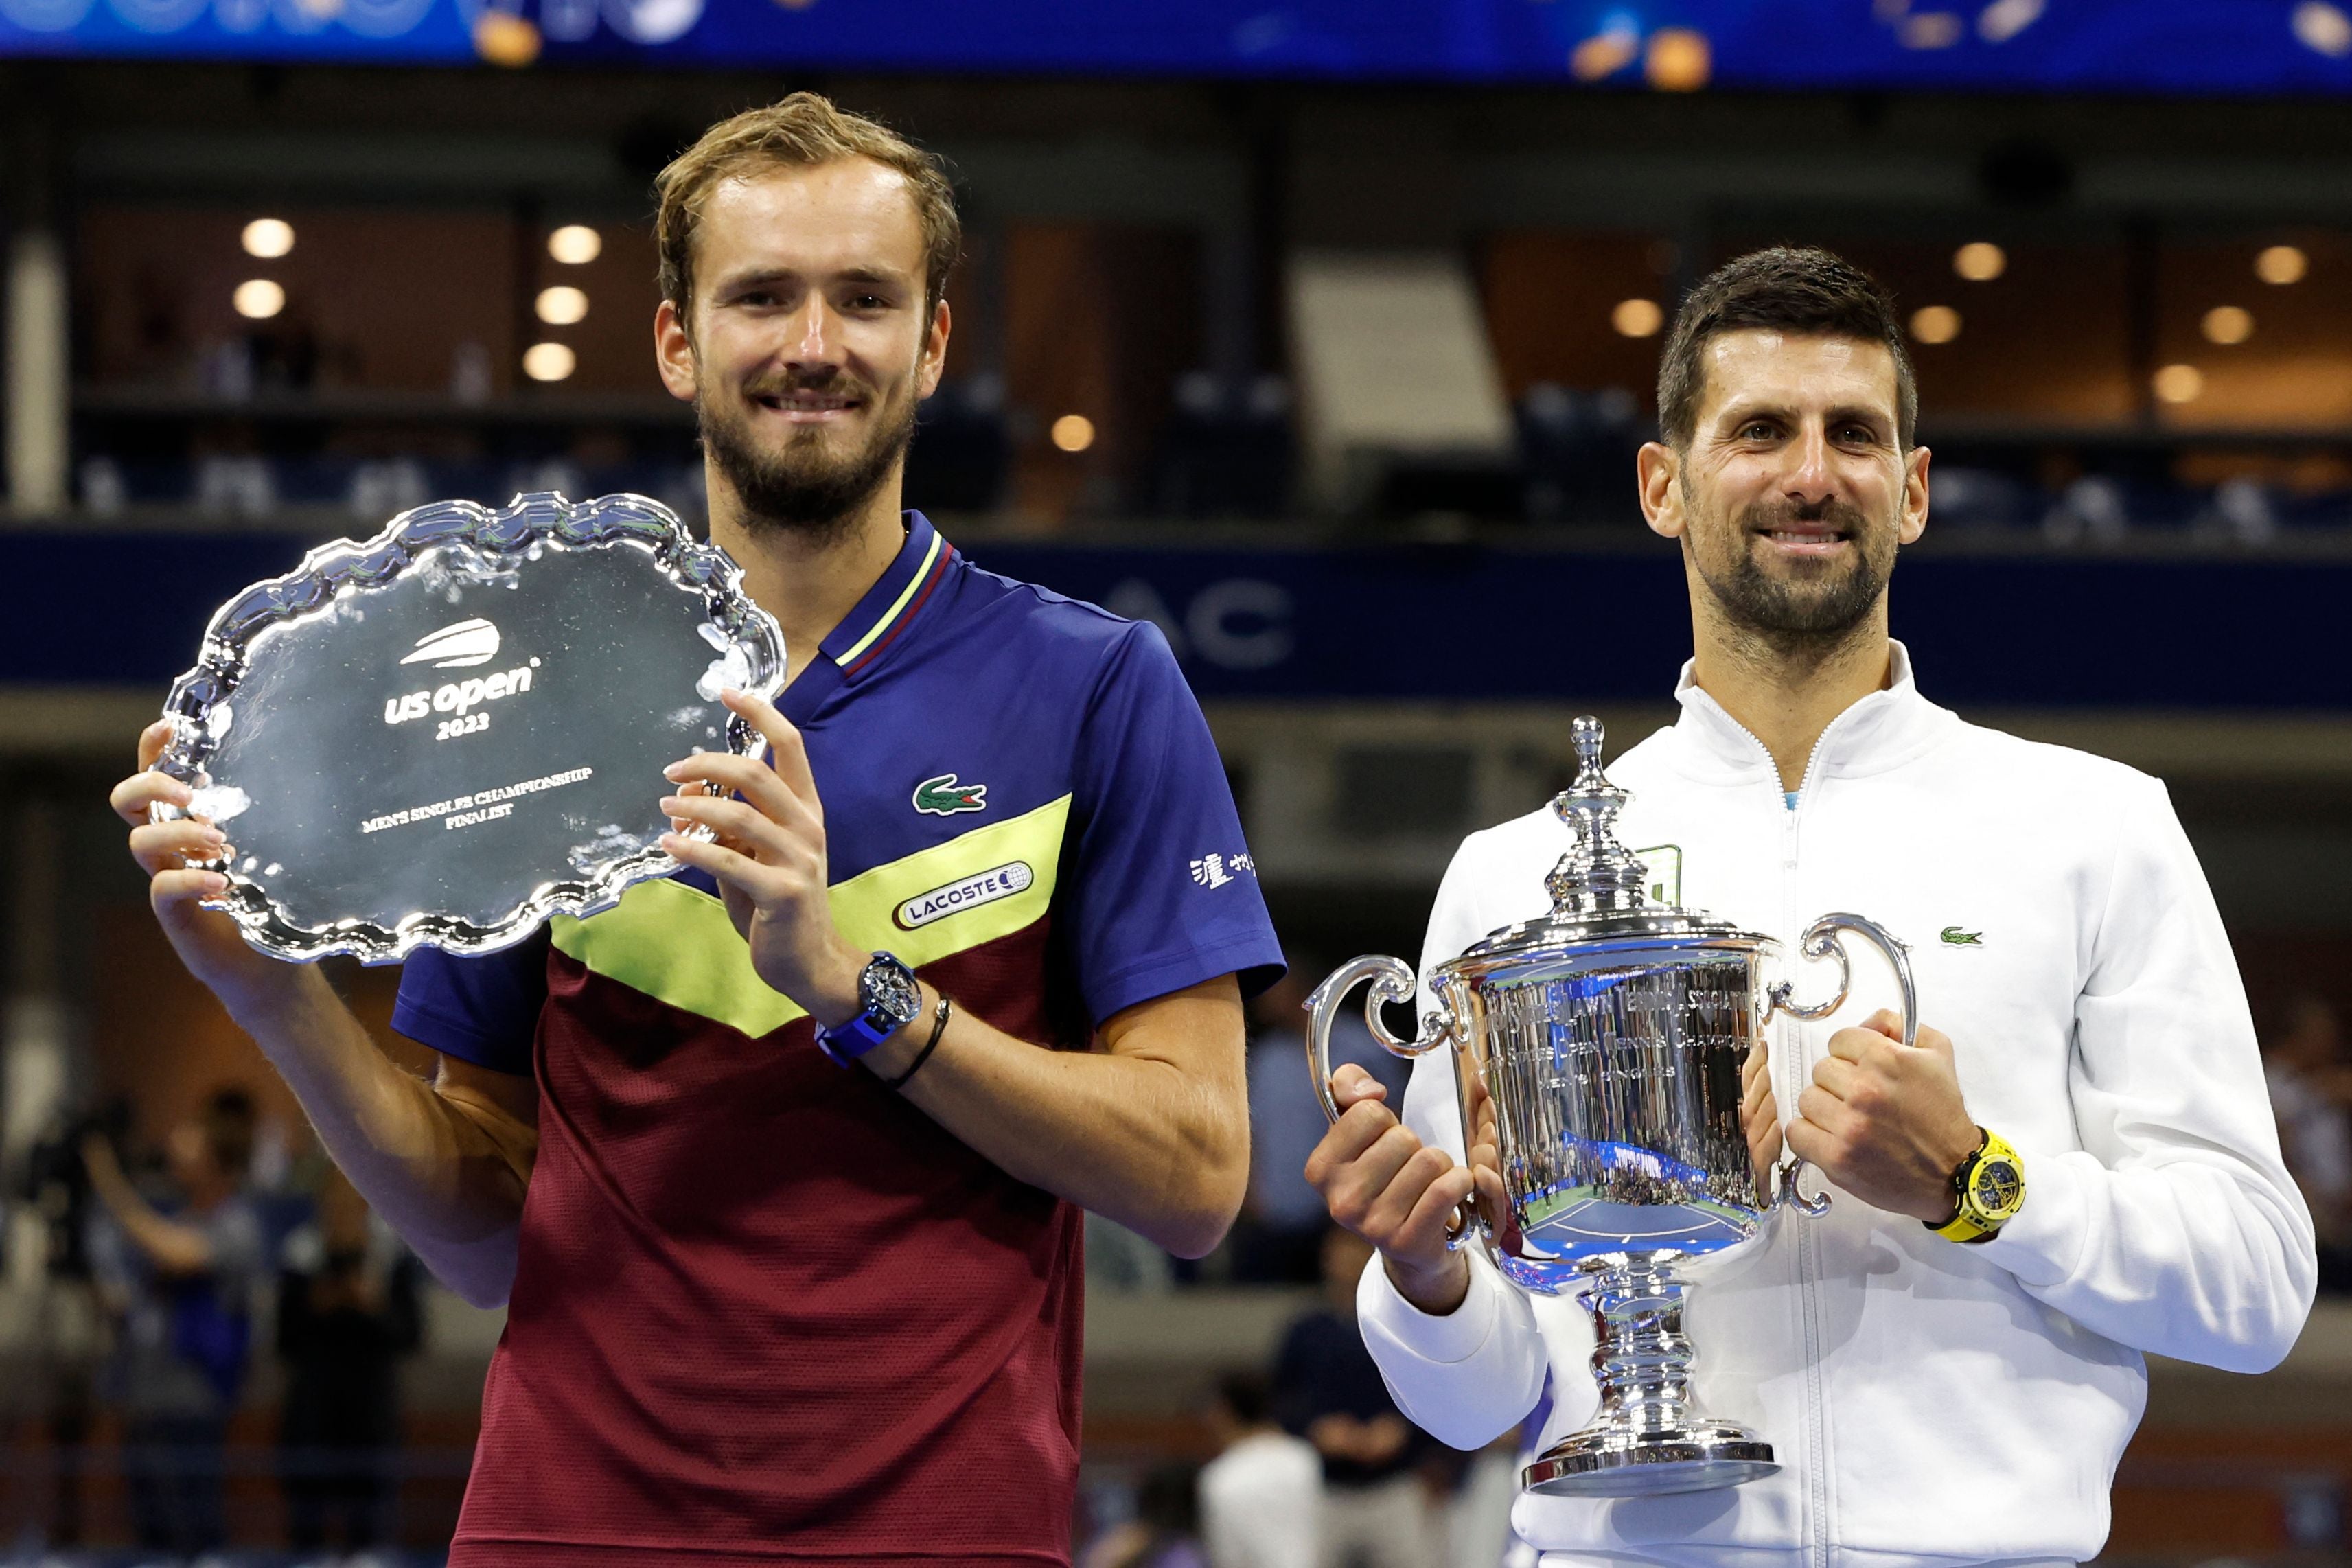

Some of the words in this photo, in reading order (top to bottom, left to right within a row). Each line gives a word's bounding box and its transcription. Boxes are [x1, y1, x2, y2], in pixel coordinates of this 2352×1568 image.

[435, 712, 490, 741] 2023
[361, 810, 410, 833] MEN'S
[410, 796, 473, 822] SINGLES
[474, 767, 593, 805] CHAMPIONSHIP
[445, 803, 514, 831] FINALIST
[910, 878, 998, 920] LACOSTE
